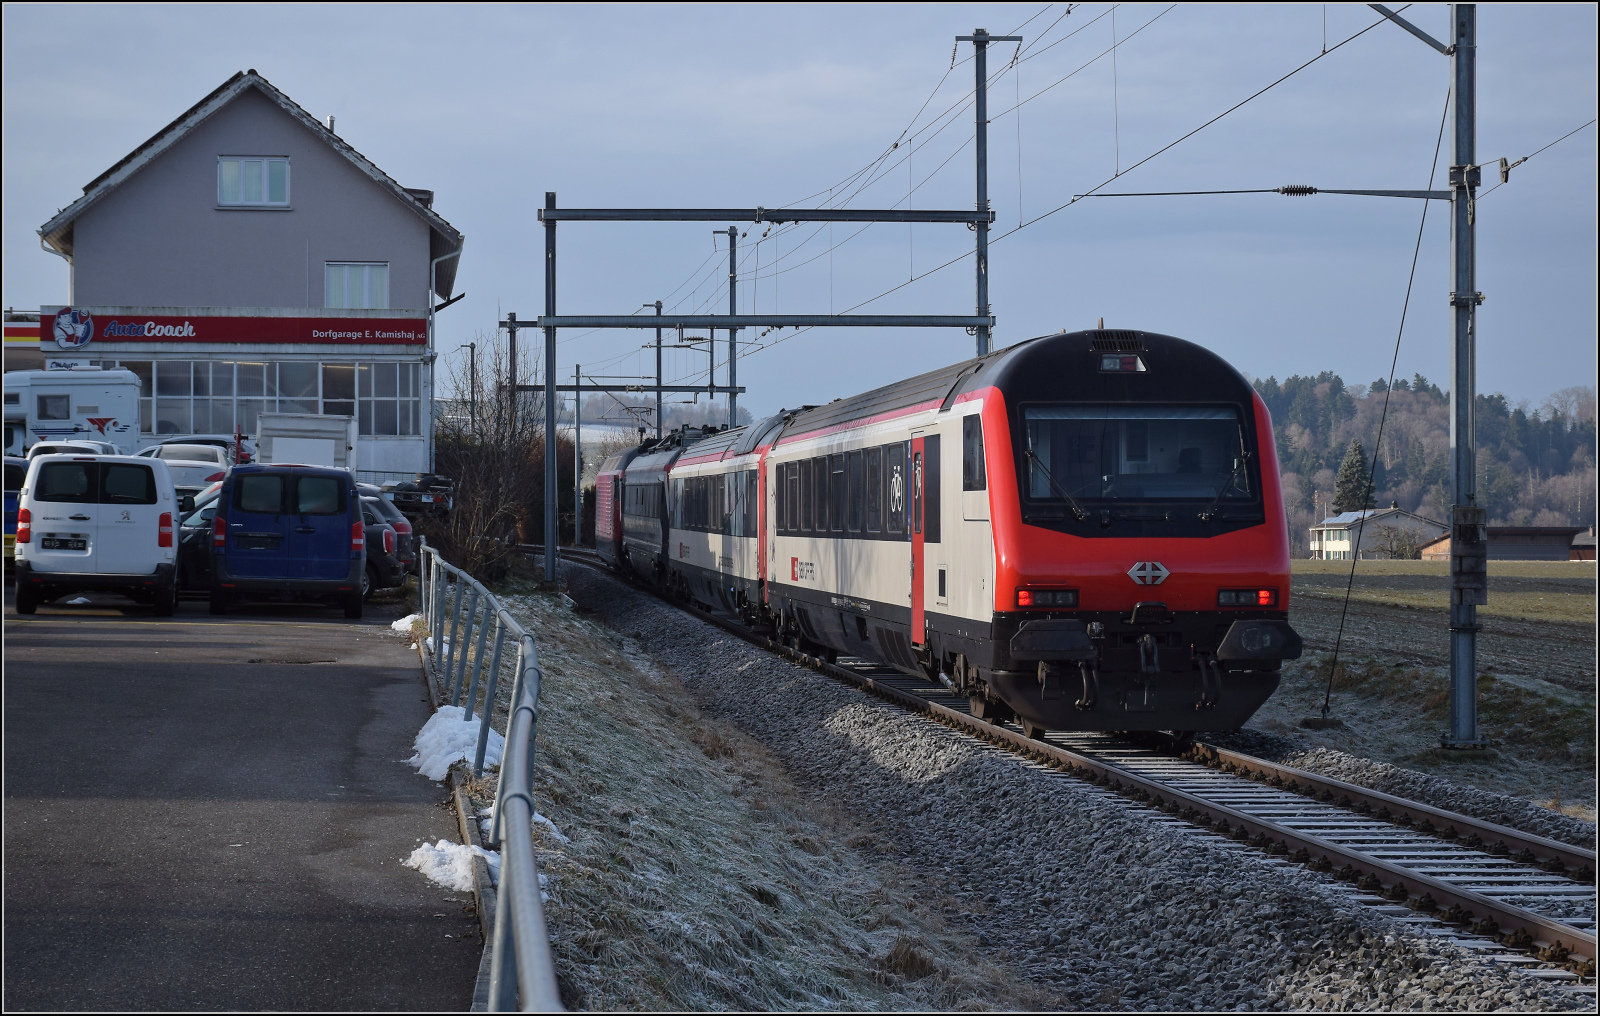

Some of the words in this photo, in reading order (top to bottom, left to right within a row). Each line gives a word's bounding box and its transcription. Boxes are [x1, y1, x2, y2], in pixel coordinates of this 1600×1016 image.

[103, 320, 196, 337] AutoCoach
[312, 329, 363, 340] Dorfgarage
[365, 330, 373, 338] E.
[375, 330, 415, 341] Kamishaj
